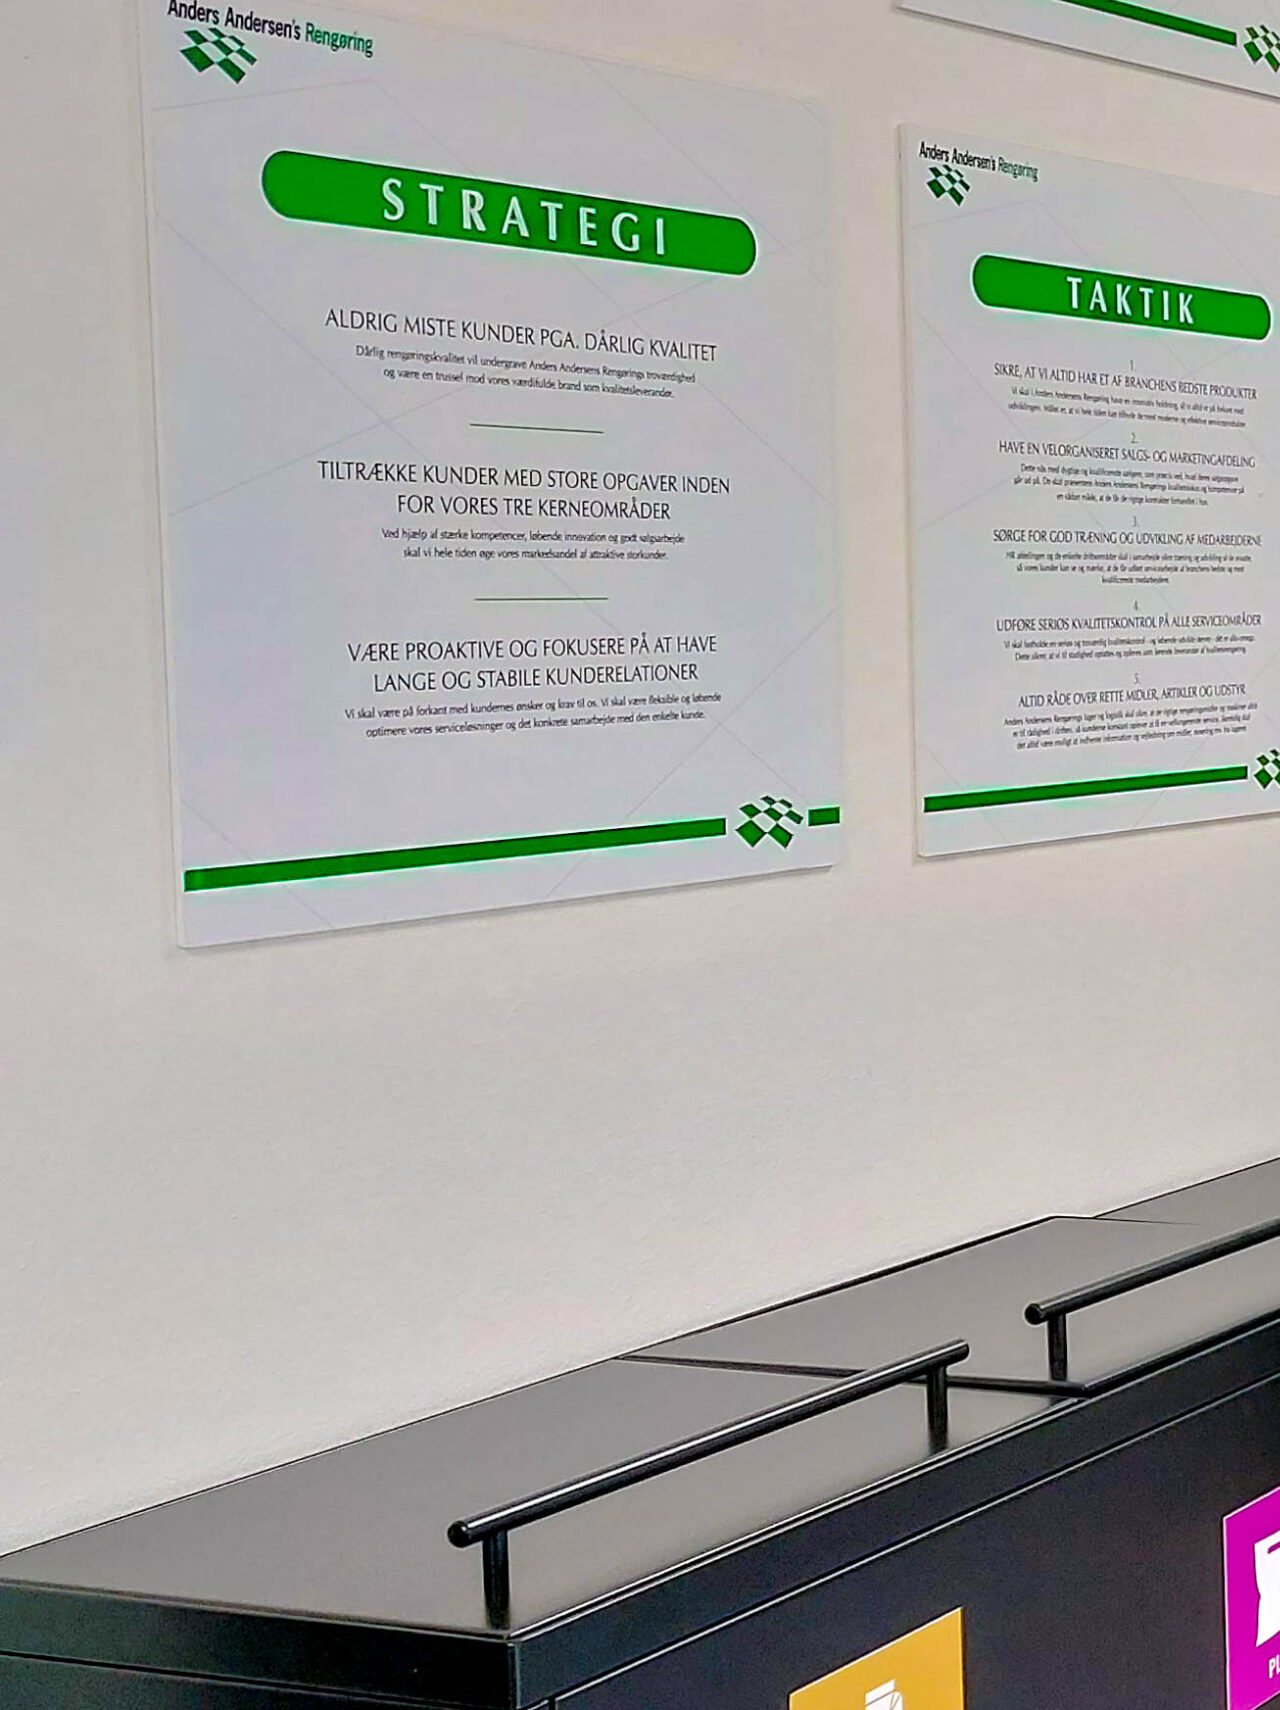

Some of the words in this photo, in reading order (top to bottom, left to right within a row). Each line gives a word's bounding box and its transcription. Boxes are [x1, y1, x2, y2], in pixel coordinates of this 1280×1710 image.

[167, 0, 220, 25] Anders
[224, 6, 301, 40] Andersen's
[306, 22, 373, 58] Rengøring
[918, 141, 949, 162] Anders
[951, 148, 996, 171] Andersen's
[382, 178, 665, 256] STRATEGI
[1066, 276, 1194, 324] TAKTIK
[325, 309, 398, 332] ALDRIG
[404, 316, 456, 338] MISTE
[462, 321, 535, 345] KUNDER
[541, 329, 579, 349] PGA.
[585, 329, 644, 355] DÅRLIG
[650, 339, 717, 361] KVALITET
[356, 345, 385, 360] Dårlig
[467, 354, 478, 365] vil
[480, 356, 527, 370] undergrave
[529, 360, 557, 372] Anders
[383, 369, 395, 379] og
[398, 370, 420, 379] være
[422, 372, 434, 380] en
[436, 371, 463, 382] trussel
[466, 373, 485, 384] mod
[488, 377, 510, 385] vores
[558, 379, 581, 391] brand
[583, 384, 600, 392] som
[1024, 366, 1036, 378] AT
[1039, 368, 1048, 380] VI
[1050, 369, 1076, 382] ALTID
[1079, 371, 1098, 384] HAR
[1100, 373, 1110, 386] ET
[1112, 375, 1122, 386] AF
[1125, 376, 1177, 392] BRANCHENS
[1210, 384, 1257, 400] PRODUKTER
[999, 440, 1024, 454] HAVE
[1027, 442, 1040, 454] EN
[1042, 443, 1120, 460] VELORGANISERET
[1152, 450, 1167, 462] OG
[317, 461, 418, 482] TILTRÆKKE
[424, 465, 499, 485] KUNDER
[504, 469, 542, 487] MED
[548, 470, 599, 489] STORE
[603, 472, 677, 492] OPGAVER
[683, 476, 730, 494] INDEN
[398, 495, 435, 513] FOR
[440, 496, 498, 515] VORES
[503, 498, 533, 516] TRE
[539, 496, 671, 519] KERNEOMRÅDER
[564, 533, 606, 542] innovation
[608, 535, 619, 544] og
[1028, 530, 1047, 542] FOR
[1050, 530, 1073, 543] GOD
[1119, 532, 1134, 544] OG
[1136, 533, 1183, 545] UDVIKLING
[1185, 534, 1195, 544] AF
[403, 547, 420, 557] skal
[423, 547, 431, 557] vi
[434, 547, 453, 557] hele
[455, 548, 477, 558] tiden
[1159, 613, 1170, 628] PÅ
[1172, 616, 1190, 628] ALLE
[348, 643, 400, 661] VÆRE
[406, 640, 504, 660] PROAKTIVE
[509, 640, 537, 658] OG
[543, 638, 625, 656] FOKUSERE
[630, 632, 649, 654] PÅ
[653, 637, 672, 653] AT
[677, 636, 716, 652] HAVE
[374, 672, 436, 692] LANGE
[442, 671, 471, 690] OG
[477, 669, 541, 688] STABILE
[546, 664, 698, 685] KUNDERELATIONER
[345, 709, 355, 718] Vi
[357, 707, 375, 718] skal
[378, 710, 400, 718] være
[403, 706, 414, 718] på
[416, 705, 447, 716] forkant
[449, 704, 468, 714] med
[471, 702, 514, 713] kundernes
[545, 702, 556, 712] og
[558, 699, 574, 709] krav
[577, 698, 585, 708] til
[600, 698, 609, 707] Vi
[611, 696, 626, 706] skal
[681, 696, 690, 705] og
[1018, 694, 1044, 708] ALTID
[1046, 690, 1072, 706] RÅDE
[1073, 692, 1097, 705] OVER
[1100, 690, 1124, 703] RETTE
[1200, 685, 1213, 697] OG
[366, 726, 406, 738] optimere
[409, 726, 432, 734] vores
[505, 722, 516, 732] og
[518, 718, 531, 729] det
[534, 718, 568, 727] konkrete
[570, 715, 615, 726] samarbejde
[617, 714, 634, 722] med
[636, 713, 651, 722] den
